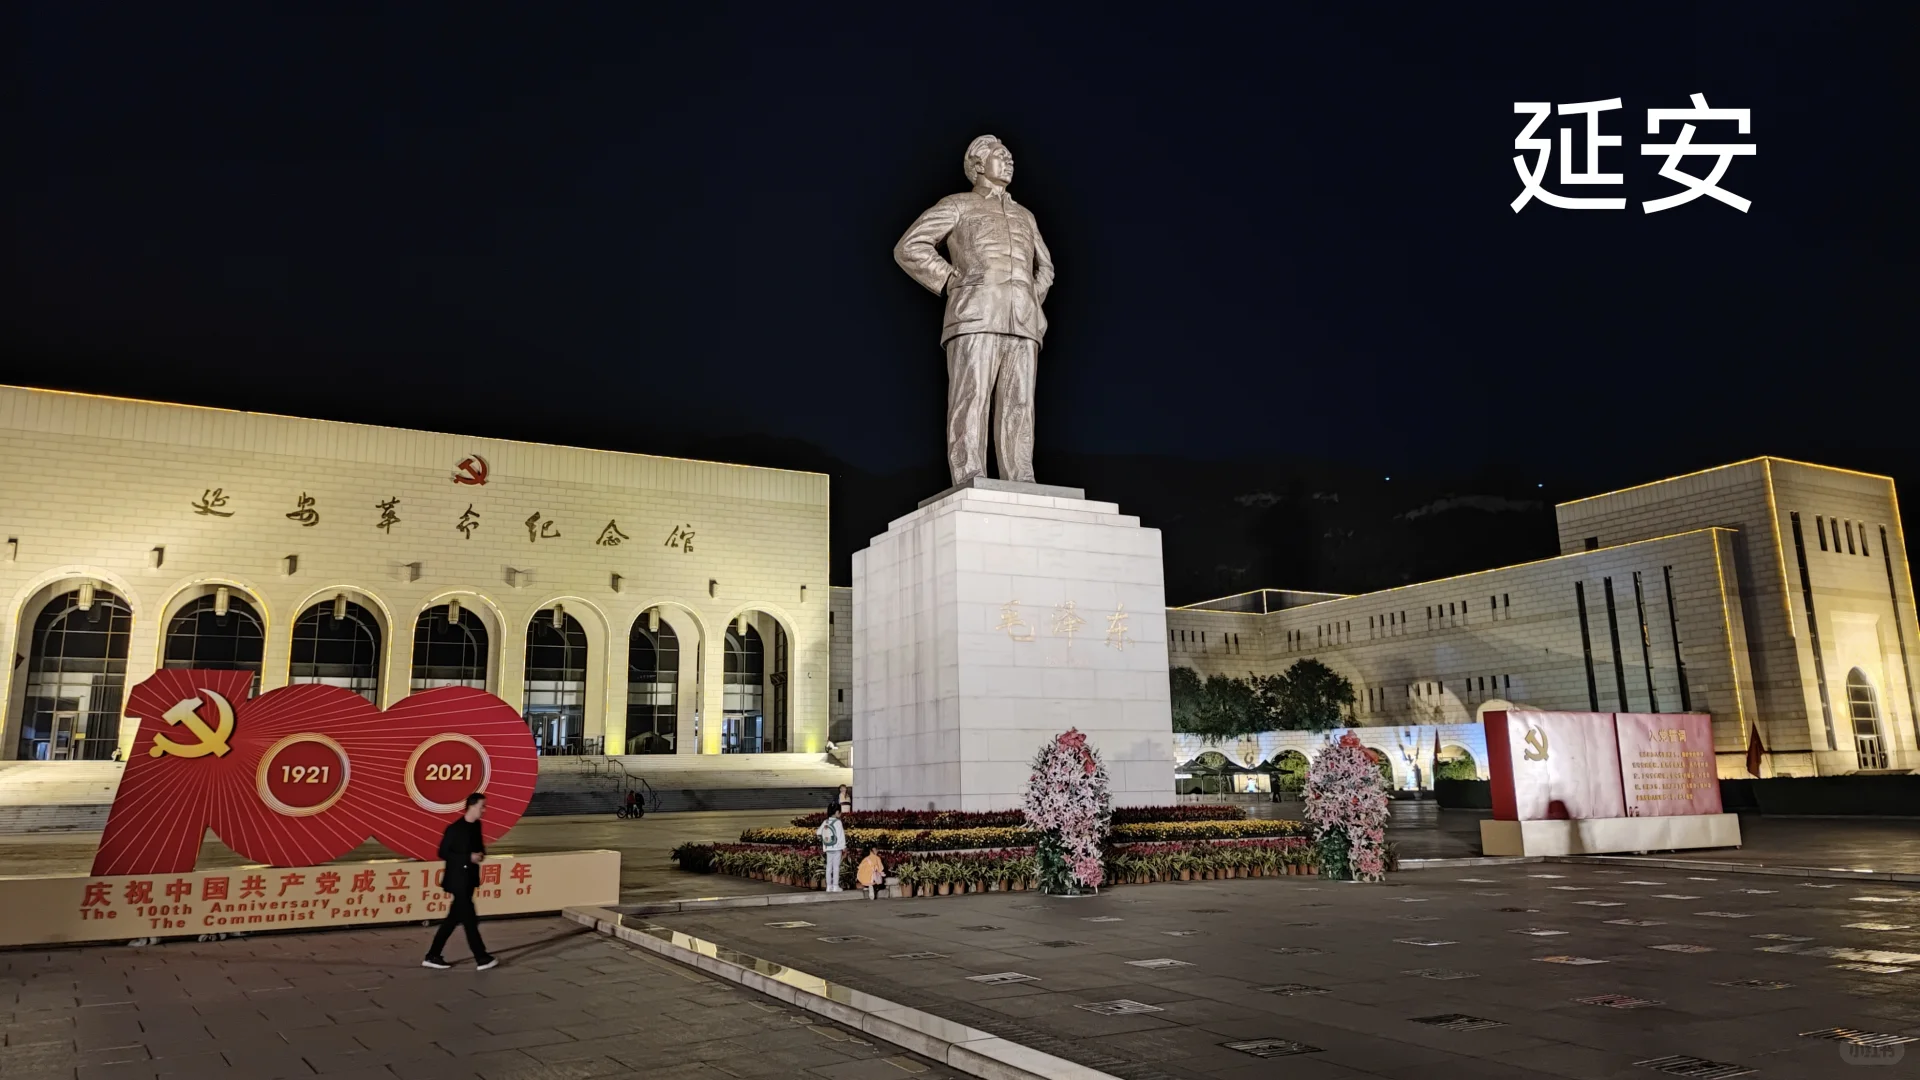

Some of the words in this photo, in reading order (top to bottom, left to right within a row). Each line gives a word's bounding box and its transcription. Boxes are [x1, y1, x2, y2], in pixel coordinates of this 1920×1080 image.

[192, 488, 695, 553] 延安革命纪念馆
[995, 600, 1136, 651] 毛泽东
[281, 765, 330, 784] 1921
[425, 763, 472, 781] 2021
[80, 908, 117, 920] The
[136, 904, 192, 917] 100th
[210, 896, 329, 914] Anniversary
[346, 894, 364, 905] of
[379, 892, 407, 904] the
[422, 887, 502, 901] Fouing
[516, 884, 532, 895] of
[149, 917, 186, 929] The
[203, 910, 315, 927] Communist
[331, 906, 380, 919] Party
[395, 903, 412, 914] of
